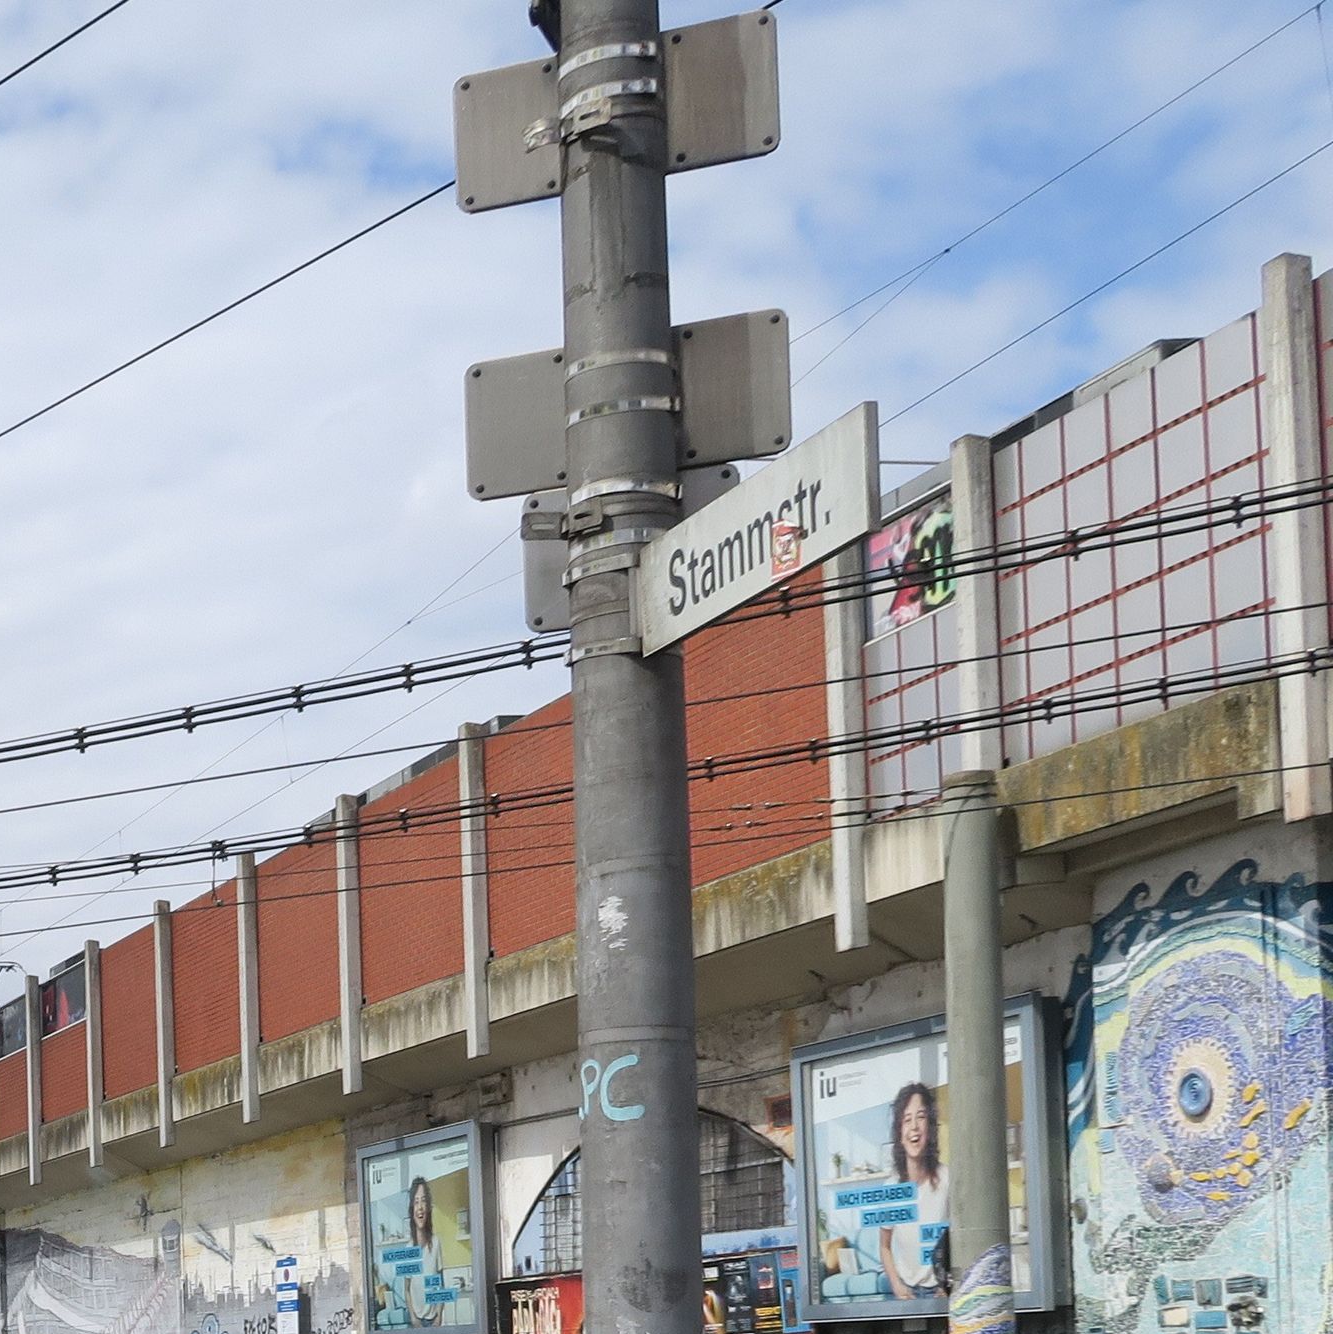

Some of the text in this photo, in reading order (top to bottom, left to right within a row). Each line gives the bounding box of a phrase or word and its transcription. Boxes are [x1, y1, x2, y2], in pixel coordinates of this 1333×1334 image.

[819, 1071, 837, 1099] iu
[837, 1185, 913, 1208] NACH FEIERABEND
[863, 1209, 915, 1226] STUDIEREN.
